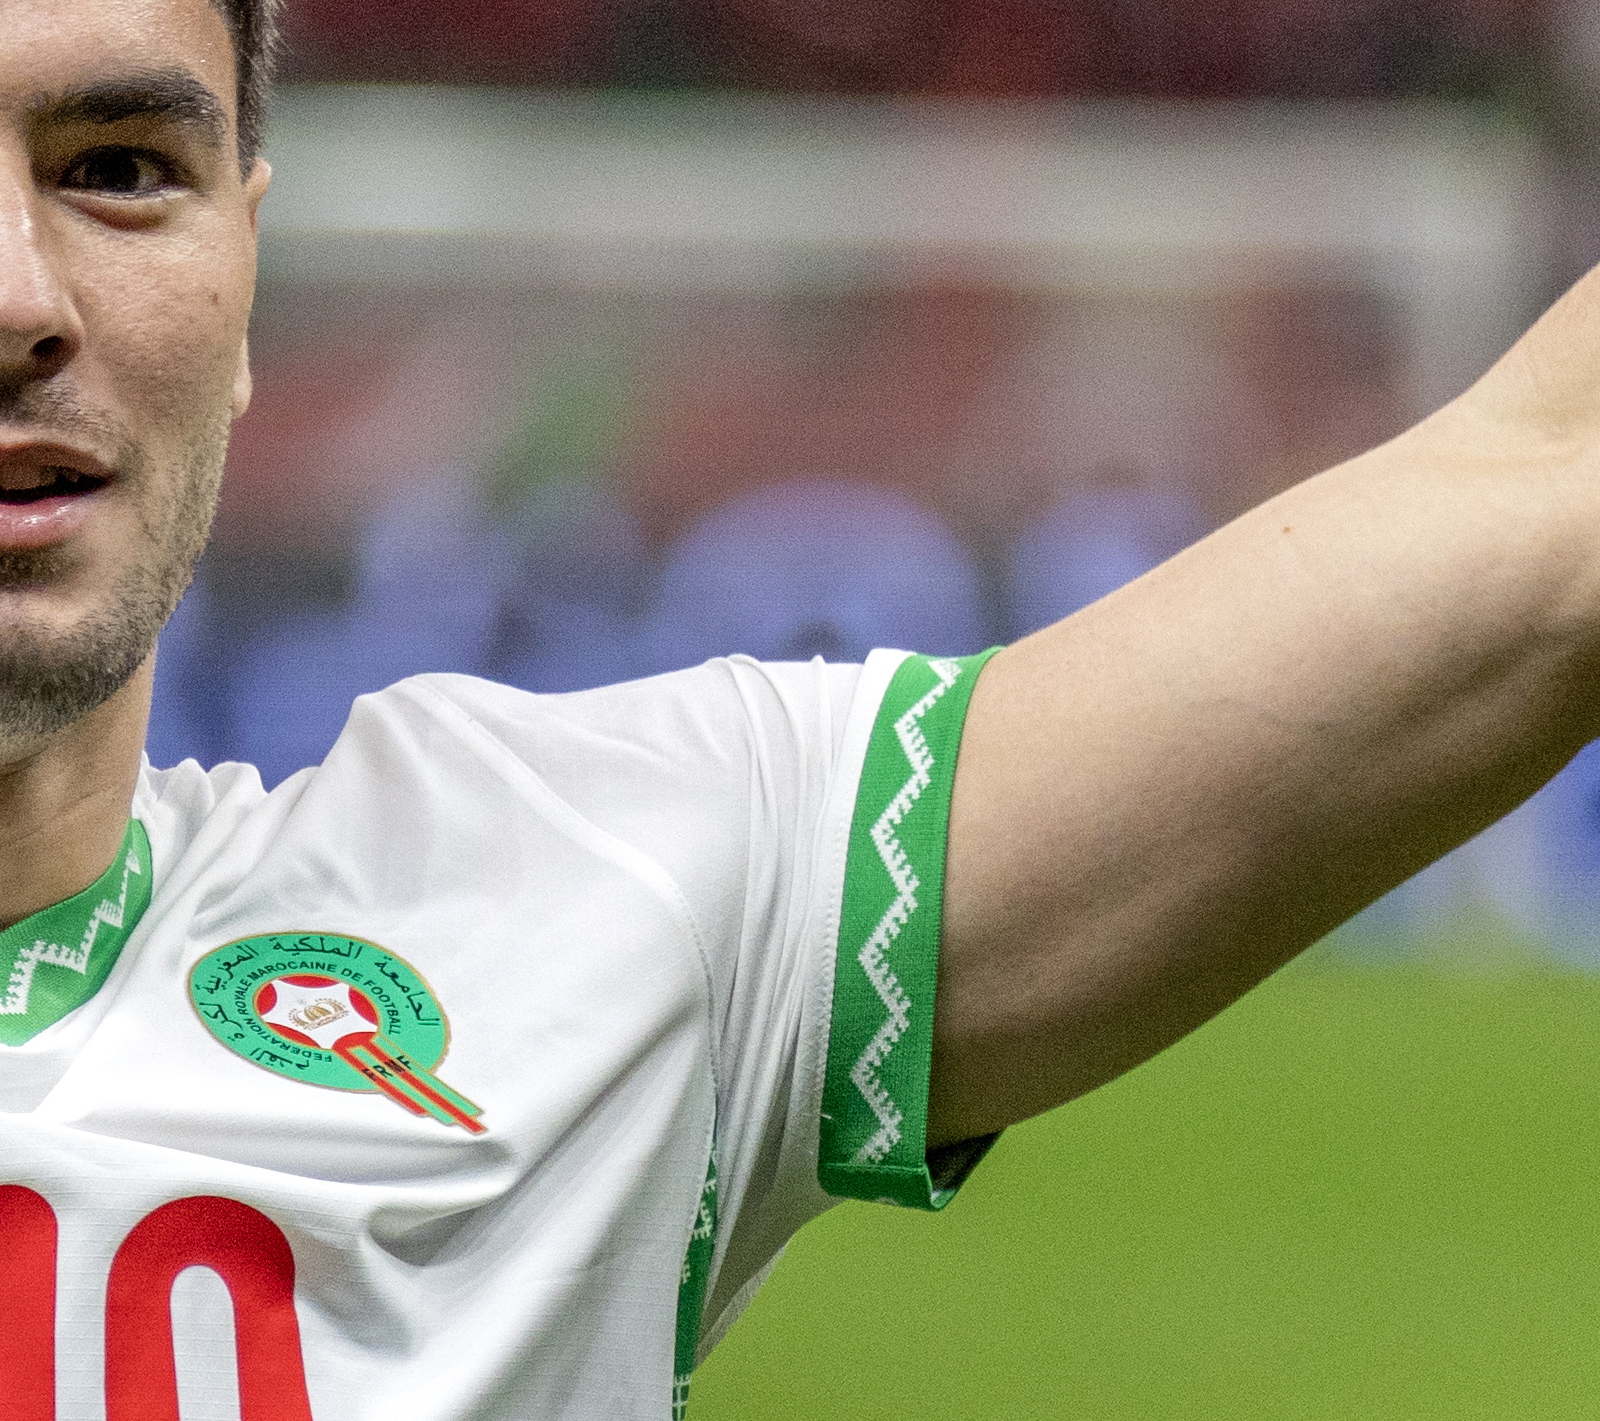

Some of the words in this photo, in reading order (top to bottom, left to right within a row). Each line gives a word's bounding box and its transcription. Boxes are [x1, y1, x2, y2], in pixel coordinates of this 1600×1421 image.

[269, 936, 363, 959] الملكية
[195, 944, 260, 994] المغربية
[247, 961, 338, 981] MAROCAINE
[341, 968, 364, 981] DE
[234, 979, 252, 1016] ROYALE
[363, 979, 402, 1035] FOOTBALL
[375, 956, 441, 1027] الجامعة
[199, 1002, 245, 1041] لكرة
[245, 1018, 332, 1062] FEDERATION
[250, 1047, 310, 1071] القدم
